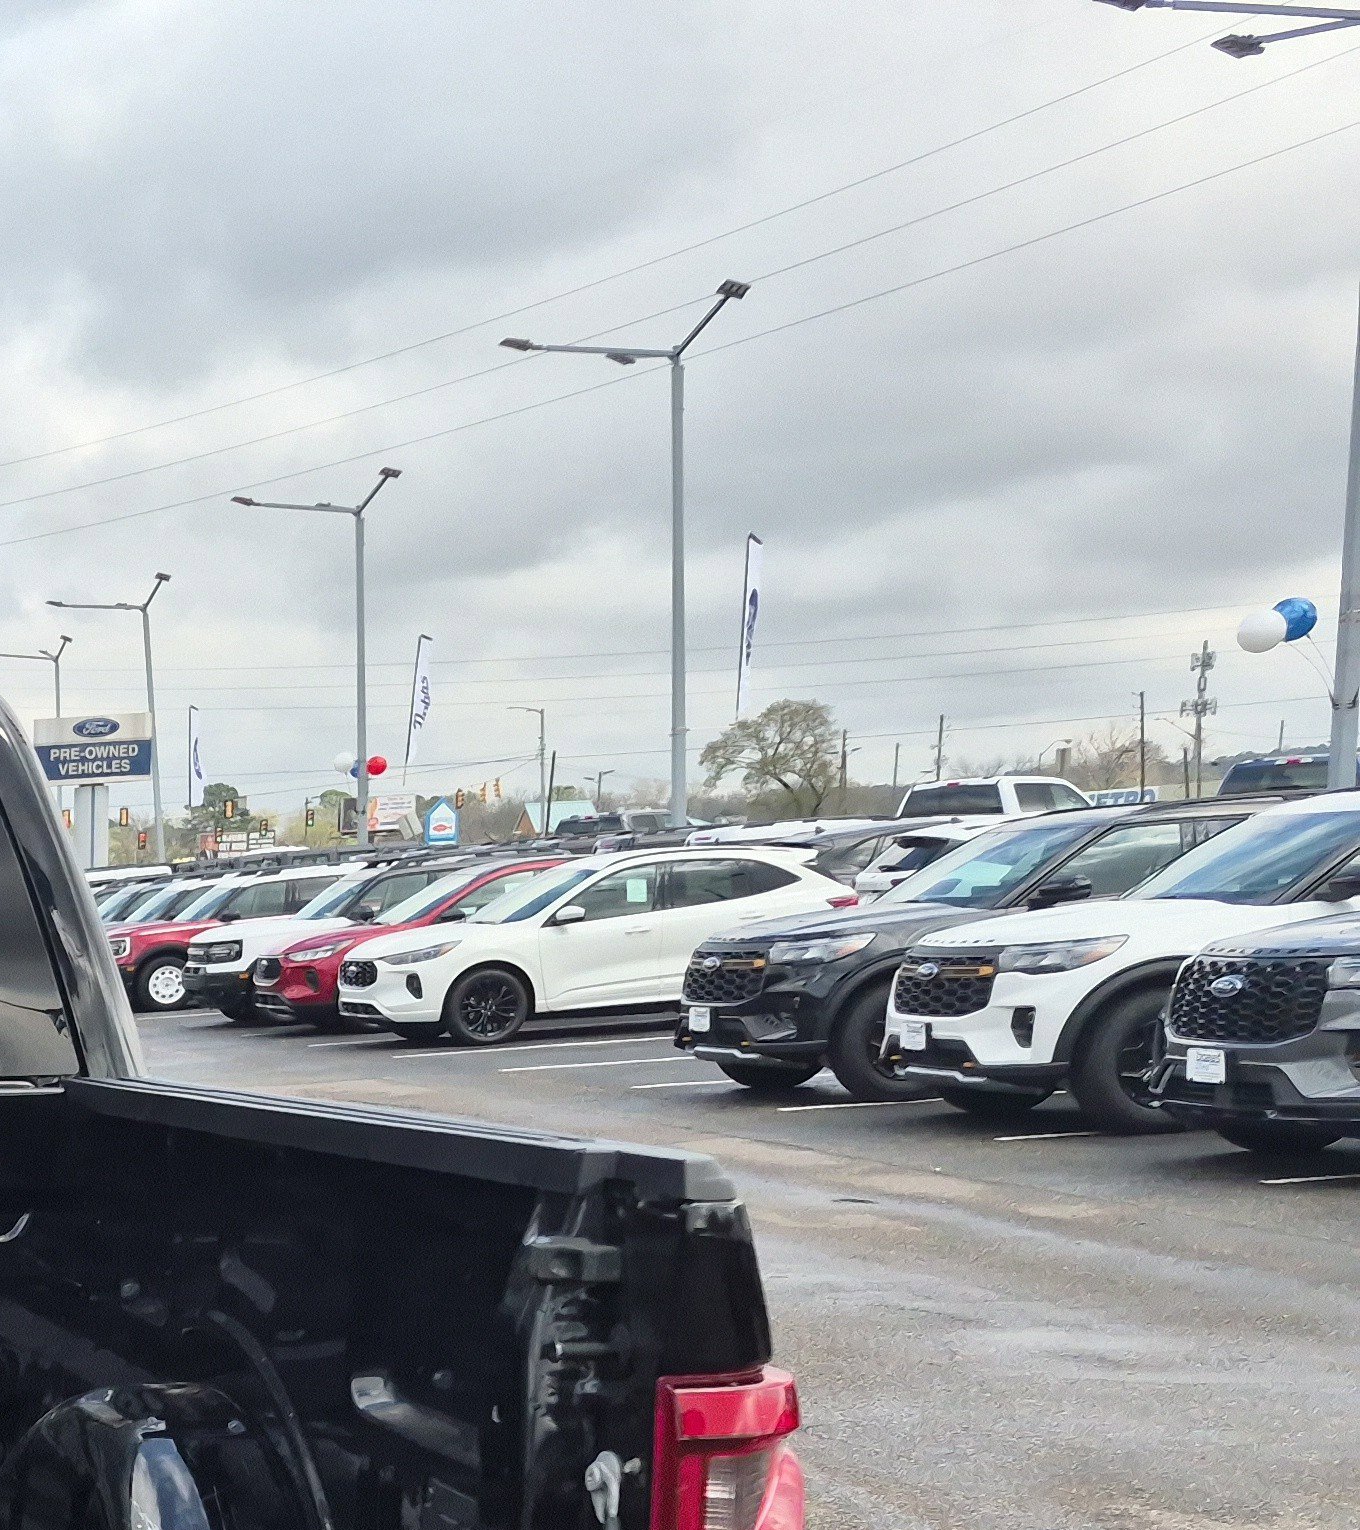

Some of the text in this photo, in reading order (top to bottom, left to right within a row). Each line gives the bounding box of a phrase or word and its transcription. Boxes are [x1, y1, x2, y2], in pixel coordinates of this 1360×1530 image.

[82, 720, 112, 735] Ford
[49, 744, 139, 761] PRE-OWNED
[58, 759, 131, 776] VEHICLES
